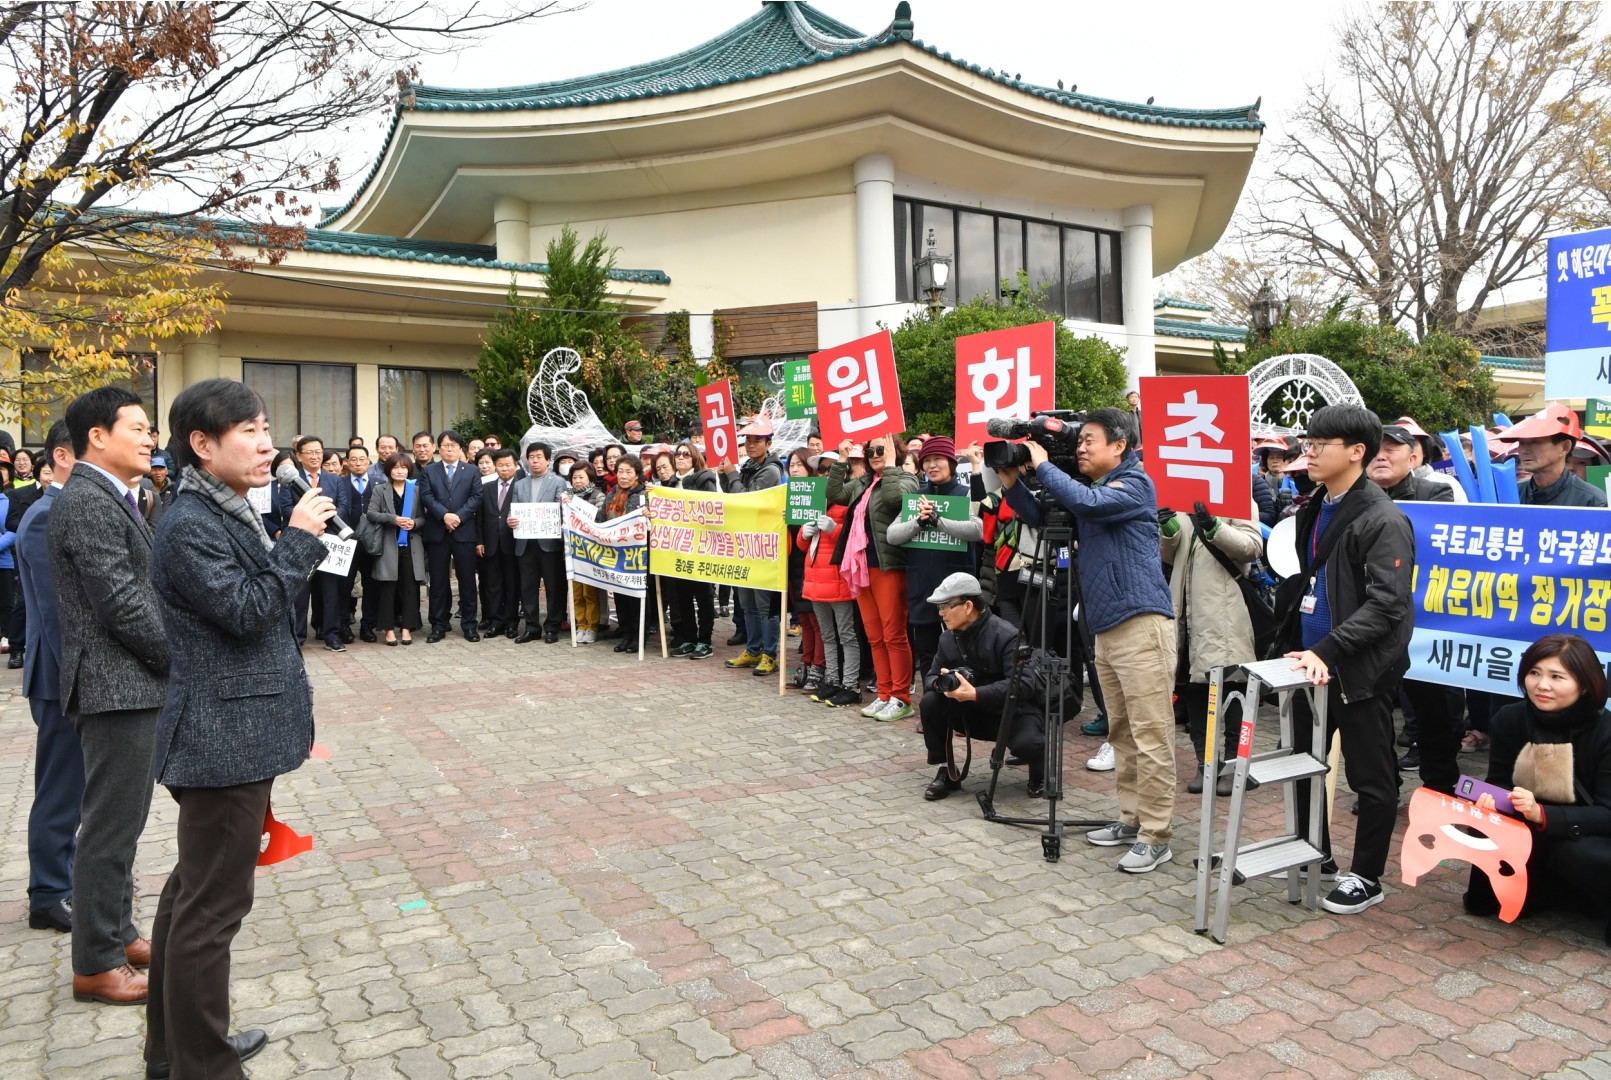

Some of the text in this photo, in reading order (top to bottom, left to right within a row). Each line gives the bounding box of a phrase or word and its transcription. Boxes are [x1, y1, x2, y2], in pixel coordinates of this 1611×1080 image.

[1557, 250, 1569, 283] 옛
[826, 348, 889, 434] 원
[967, 346, 1041, 424] 화
[705, 392, 730, 458] 공
[1158, 389, 1233, 505] 촉
[649, 496, 724, 525] 명품공원 조성으로
[789, 494, 812, 506] 상업개발
[791, 508, 803, 520] 절대
[649, 524, 779, 561] 상업개발, 난개발을 방지하라!
[1430, 523, 1530, 565] 국토교통부,
[674, 558, 750, 581] 중2동 주민자치위원회
[1423, 564, 1519, 622] 해운대역
[1427, 639, 1514, 682] 새마을
[1239, 725, 1249, 745] KNN
